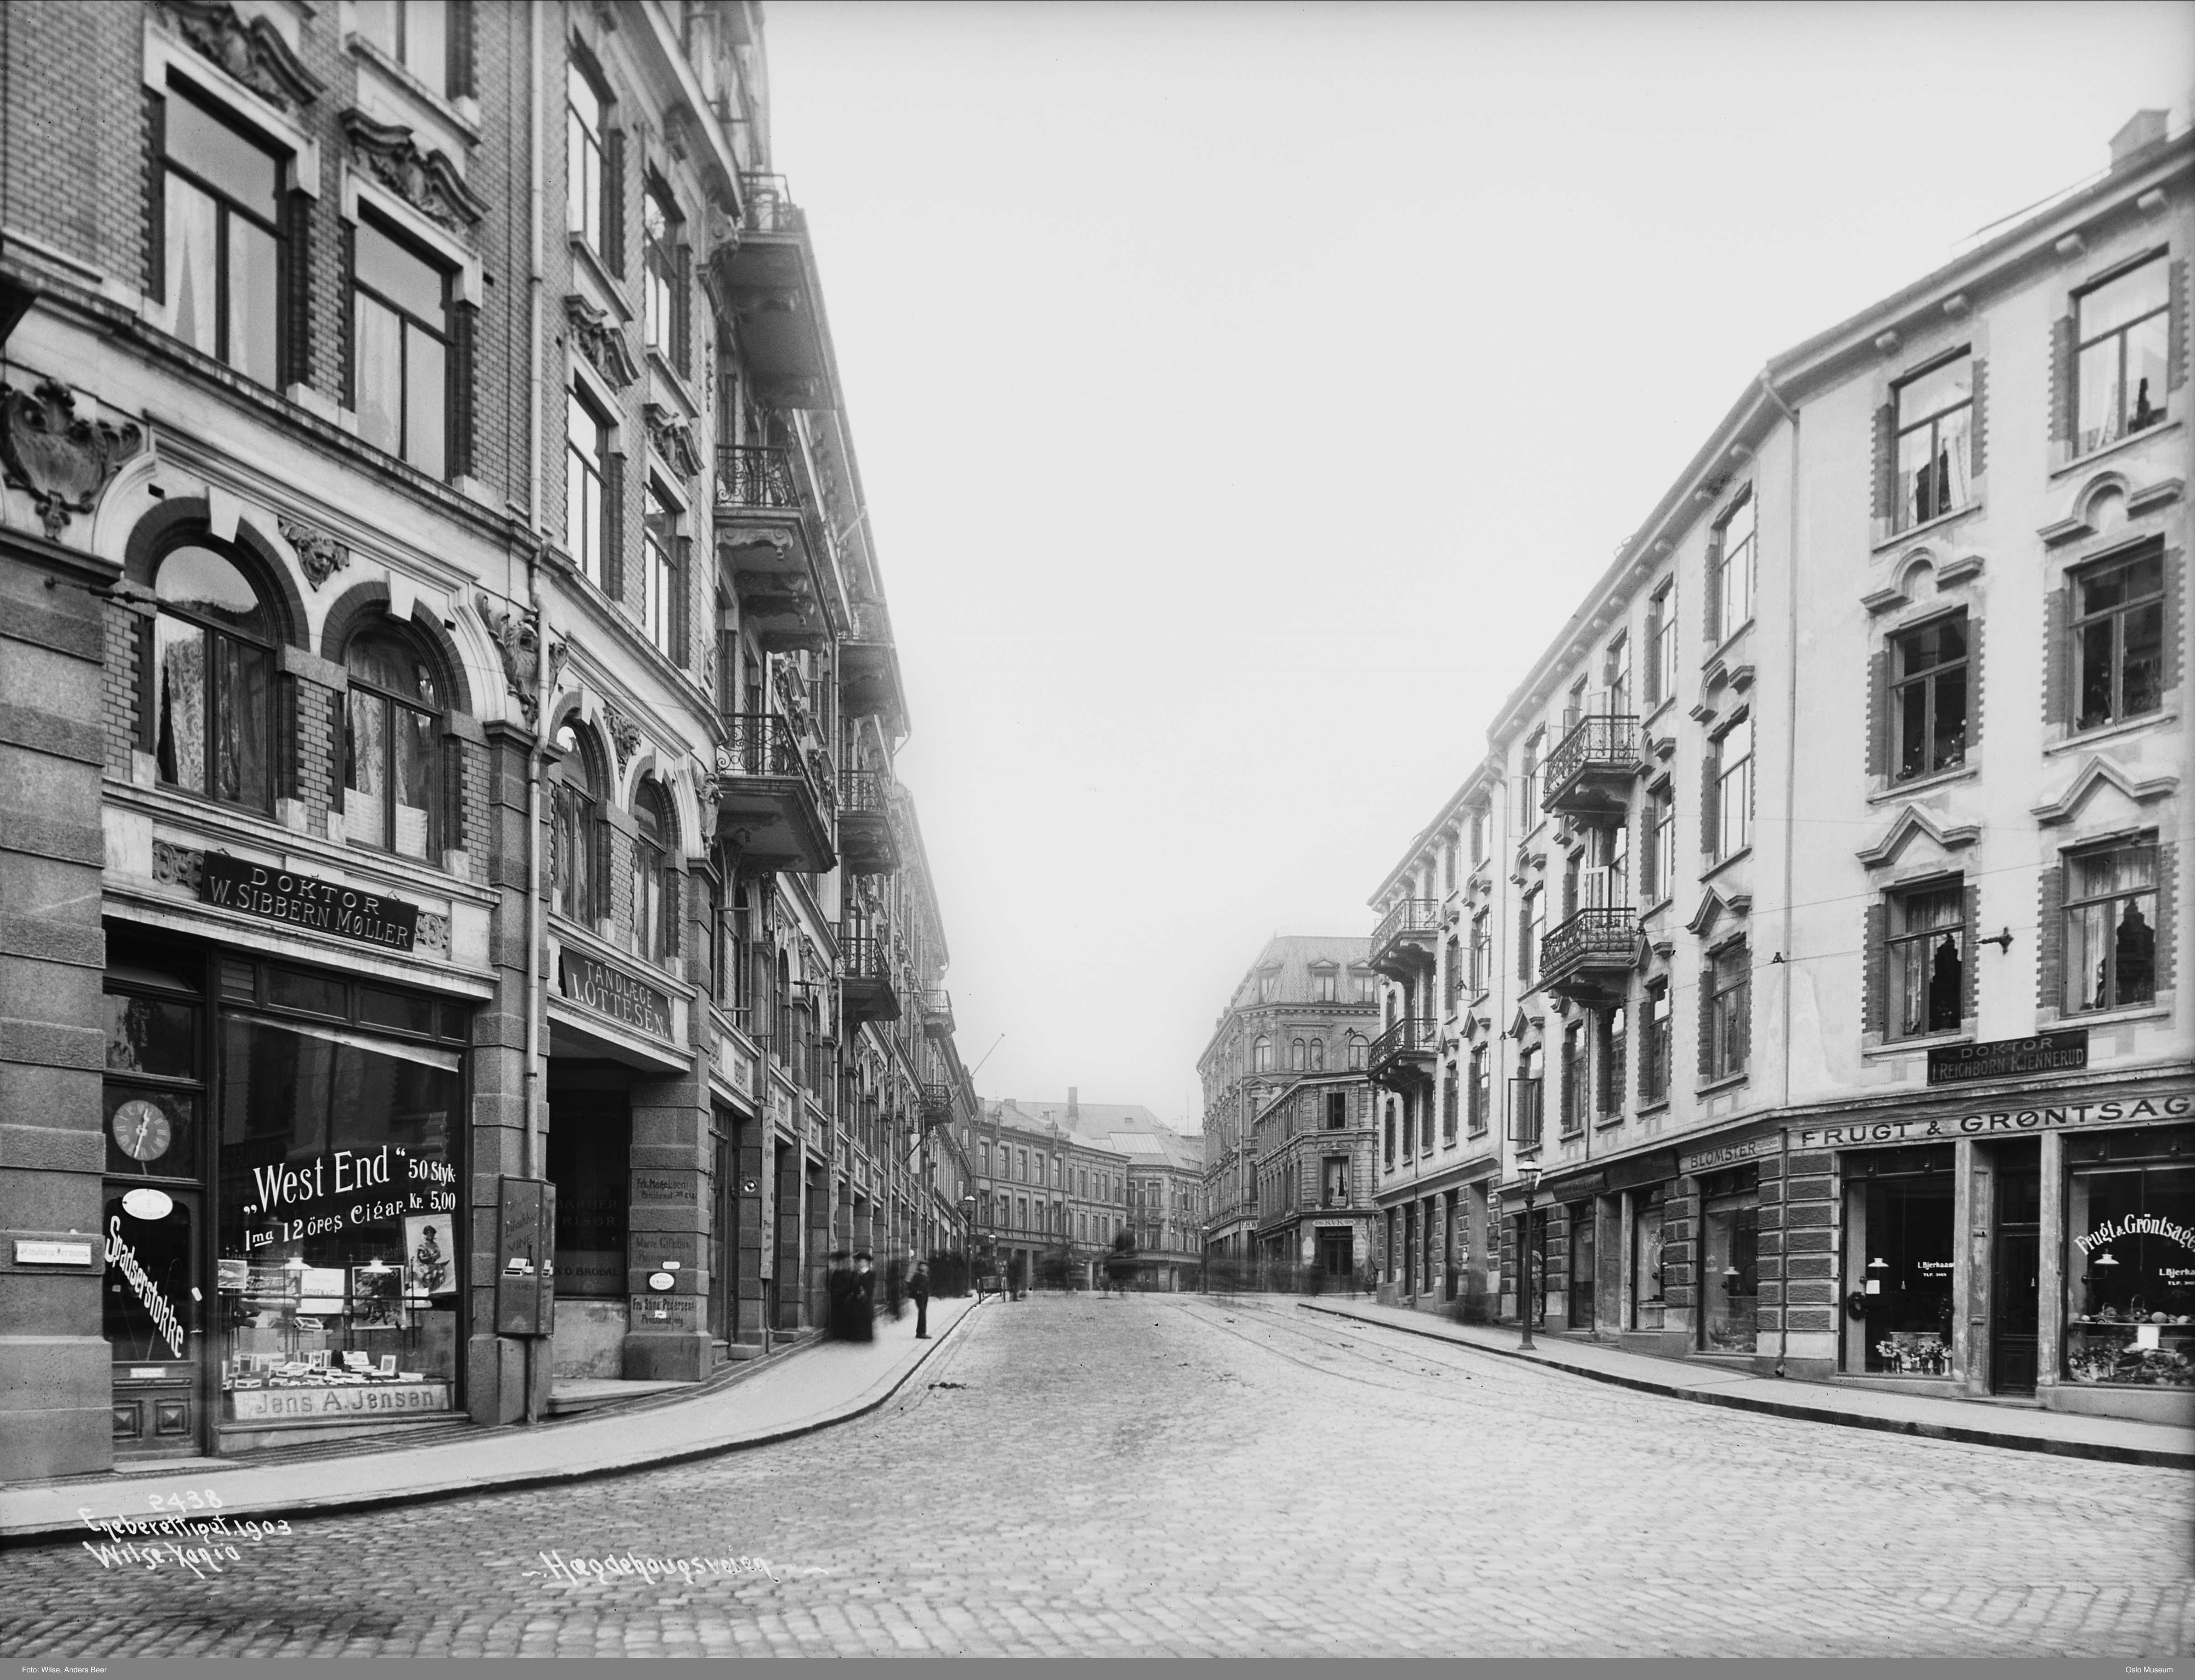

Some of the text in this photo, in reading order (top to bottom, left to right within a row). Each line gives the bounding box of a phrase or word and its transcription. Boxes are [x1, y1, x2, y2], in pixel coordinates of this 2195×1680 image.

[209, 876, 408, 946] W. SIBBERN MØLLER
[250, 867, 380, 915] DOKTOR
[584, 960, 652, 1010] TANDLÆGE
[1961, 1038, 2053, 1058] DOKTOR
[1802, 1122, 1913, 1147] FRUGT
[1926, 1121, 1943, 1136] &
[1960, 1097, 2192, 1132] GRØNTSAG
[408, 1159, 428, 1180] 50
[1691, 1141, 1757, 1169] BLOMSTER
[283, 1219, 304, 1242] 12
[350, 1200, 407, 1225] Cigar.
[409, 1191, 456, 1211] Kr. 5,00
[2074, 1214, 2195, 1255] Frugt & Gröntsage
[104, 1215, 184, 1358] Spadserstokke
[256, 1394, 312, 1413] Jens
[351, 1390, 434, 1409] Jensen
